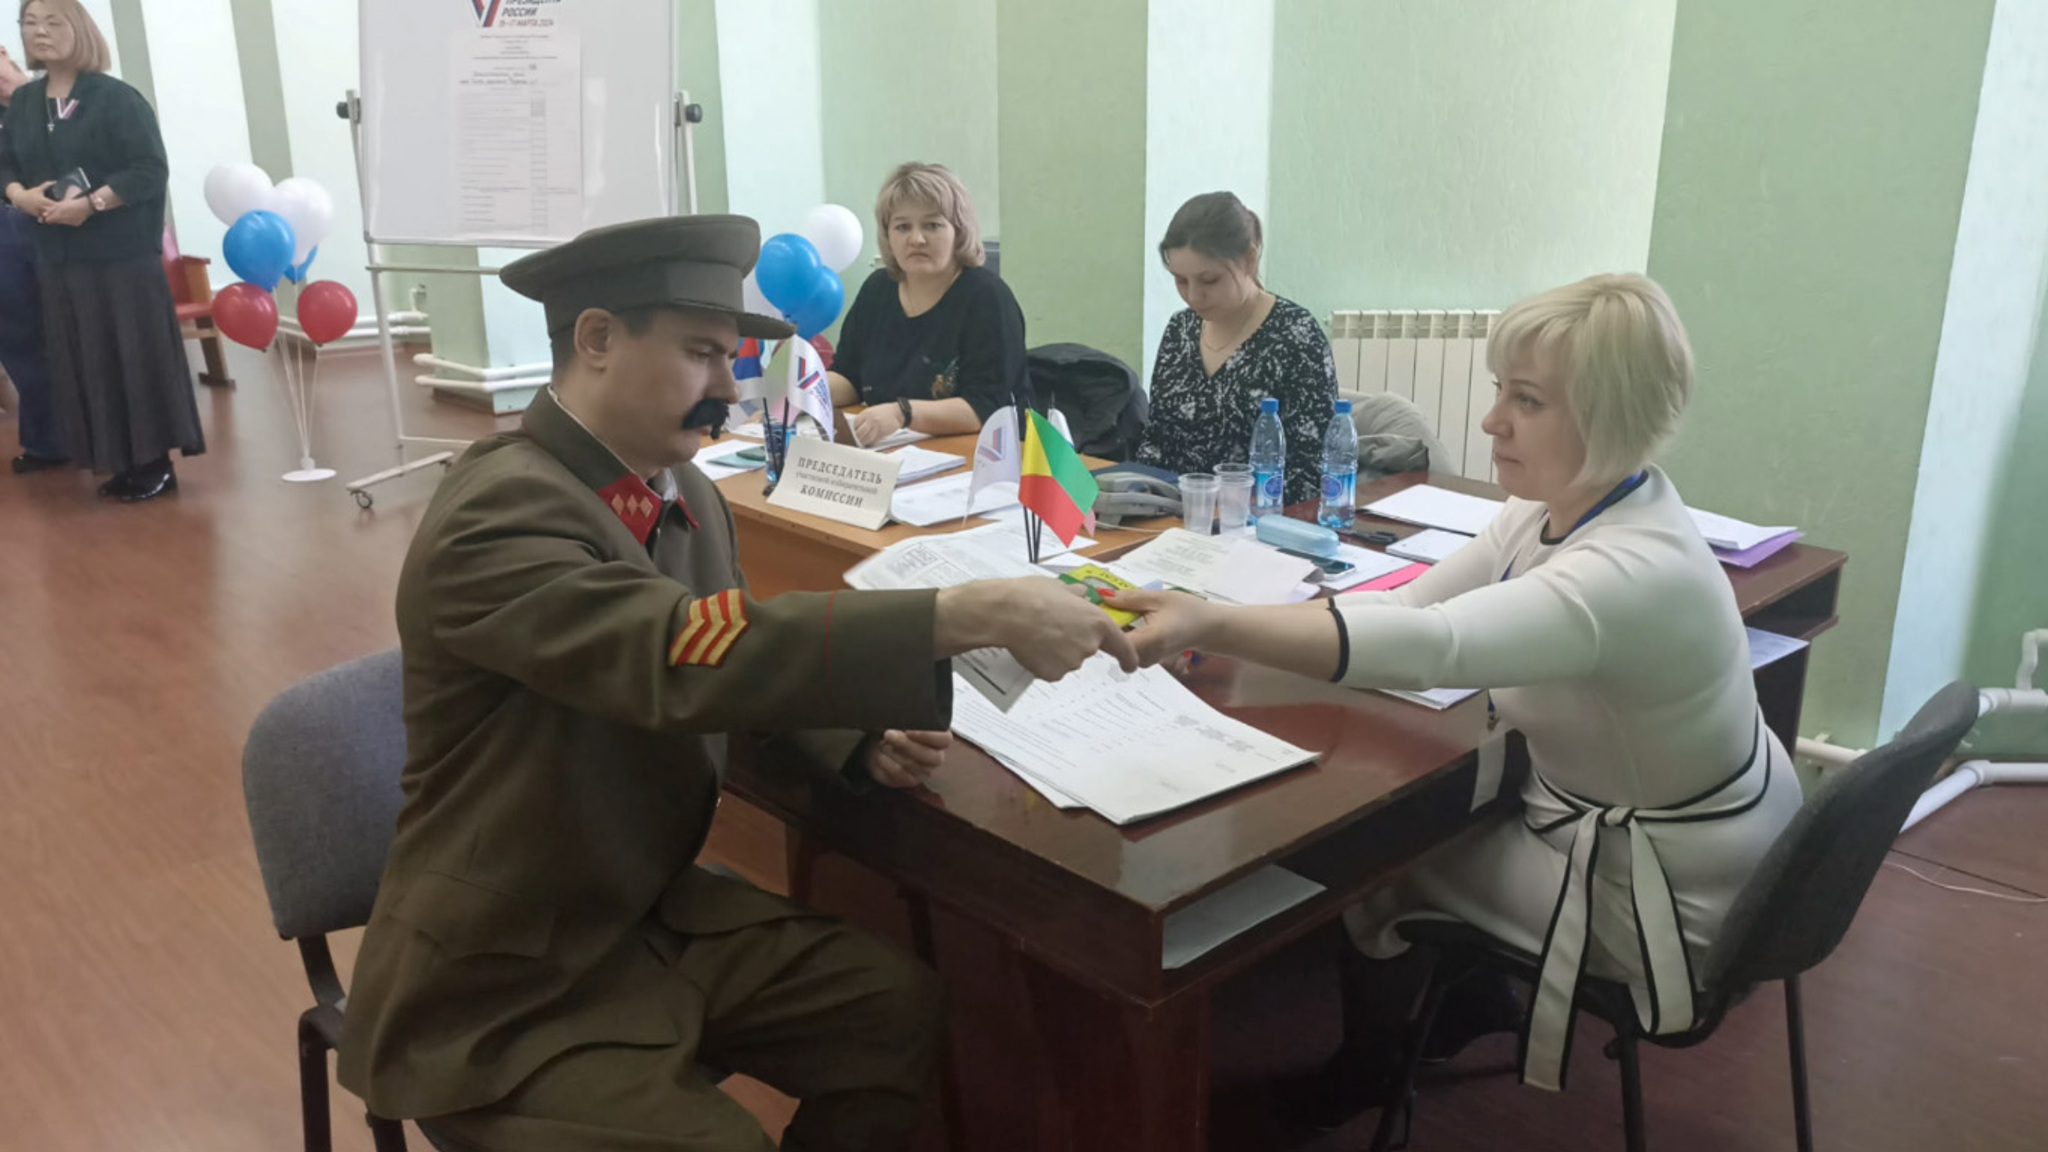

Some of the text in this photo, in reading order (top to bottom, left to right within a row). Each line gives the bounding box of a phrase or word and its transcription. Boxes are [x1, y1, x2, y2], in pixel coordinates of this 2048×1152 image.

[502, 7, 538, 17] РОССИИ
[798, 456, 883, 484] ПРЕДСЕДАТЕЛЬ
[800, 484, 864, 508] КОМИССИИ
